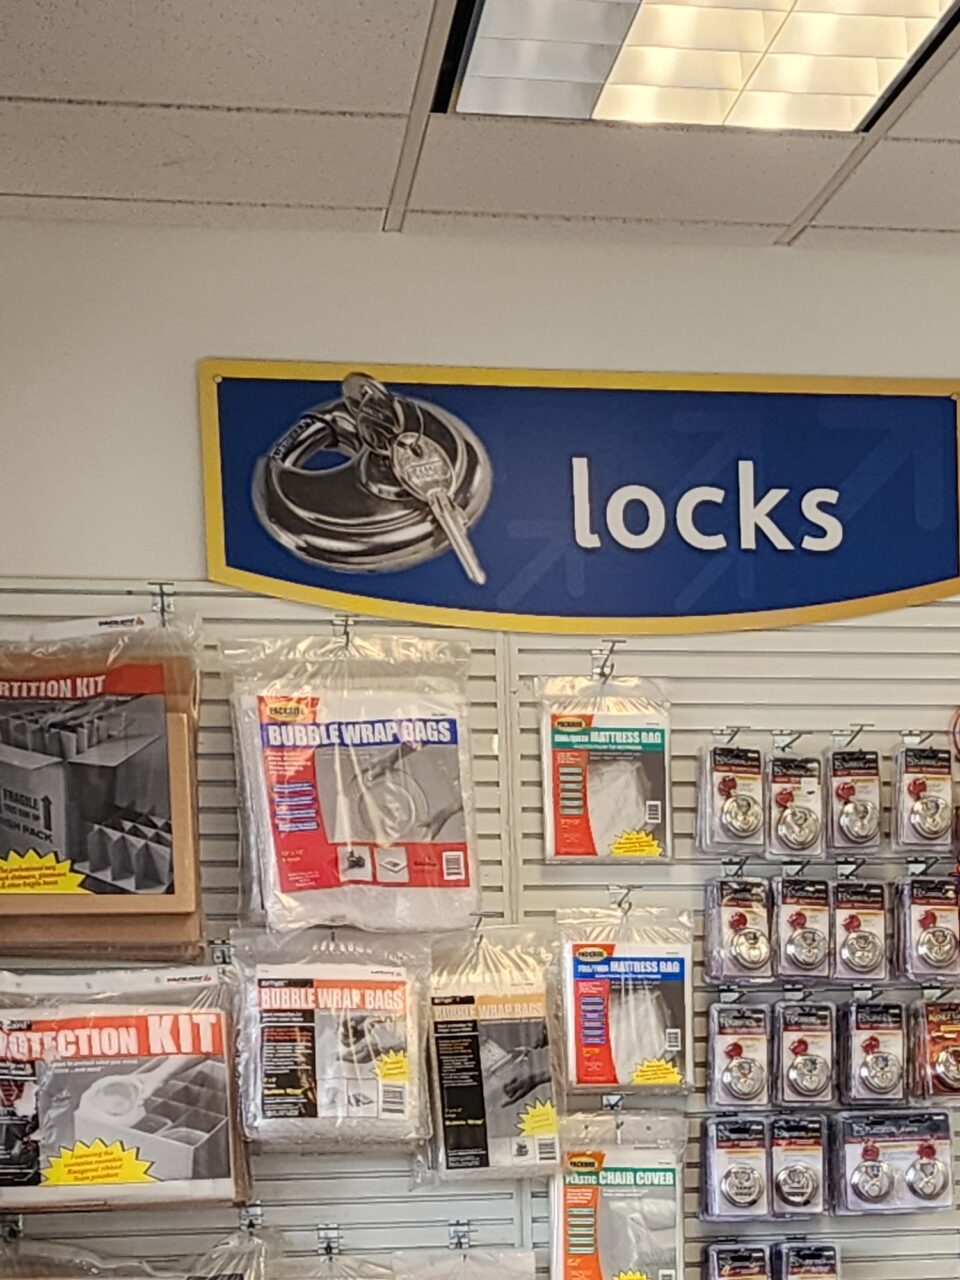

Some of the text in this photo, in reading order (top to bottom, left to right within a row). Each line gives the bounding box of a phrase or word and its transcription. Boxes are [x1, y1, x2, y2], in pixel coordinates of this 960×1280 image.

[571, 456, 845, 552] locks
[76, 675, 106, 698] KIT
[268, 720, 451, 746] BUBBLE WRAP BAGS
[590, 731, 661, 743] MATTRESS BAG
[610, 961, 680, 973] MATTRESS BAG
[261, 987, 403, 1010] BUBBLE WRAP BAGS
[434, 1001, 544, 1021] BUBBLE WRAP BAGS
[148, 1014, 217, 1055] KIT
[565, 1171, 674, 1185] PLASTIC CHAIR COVER
